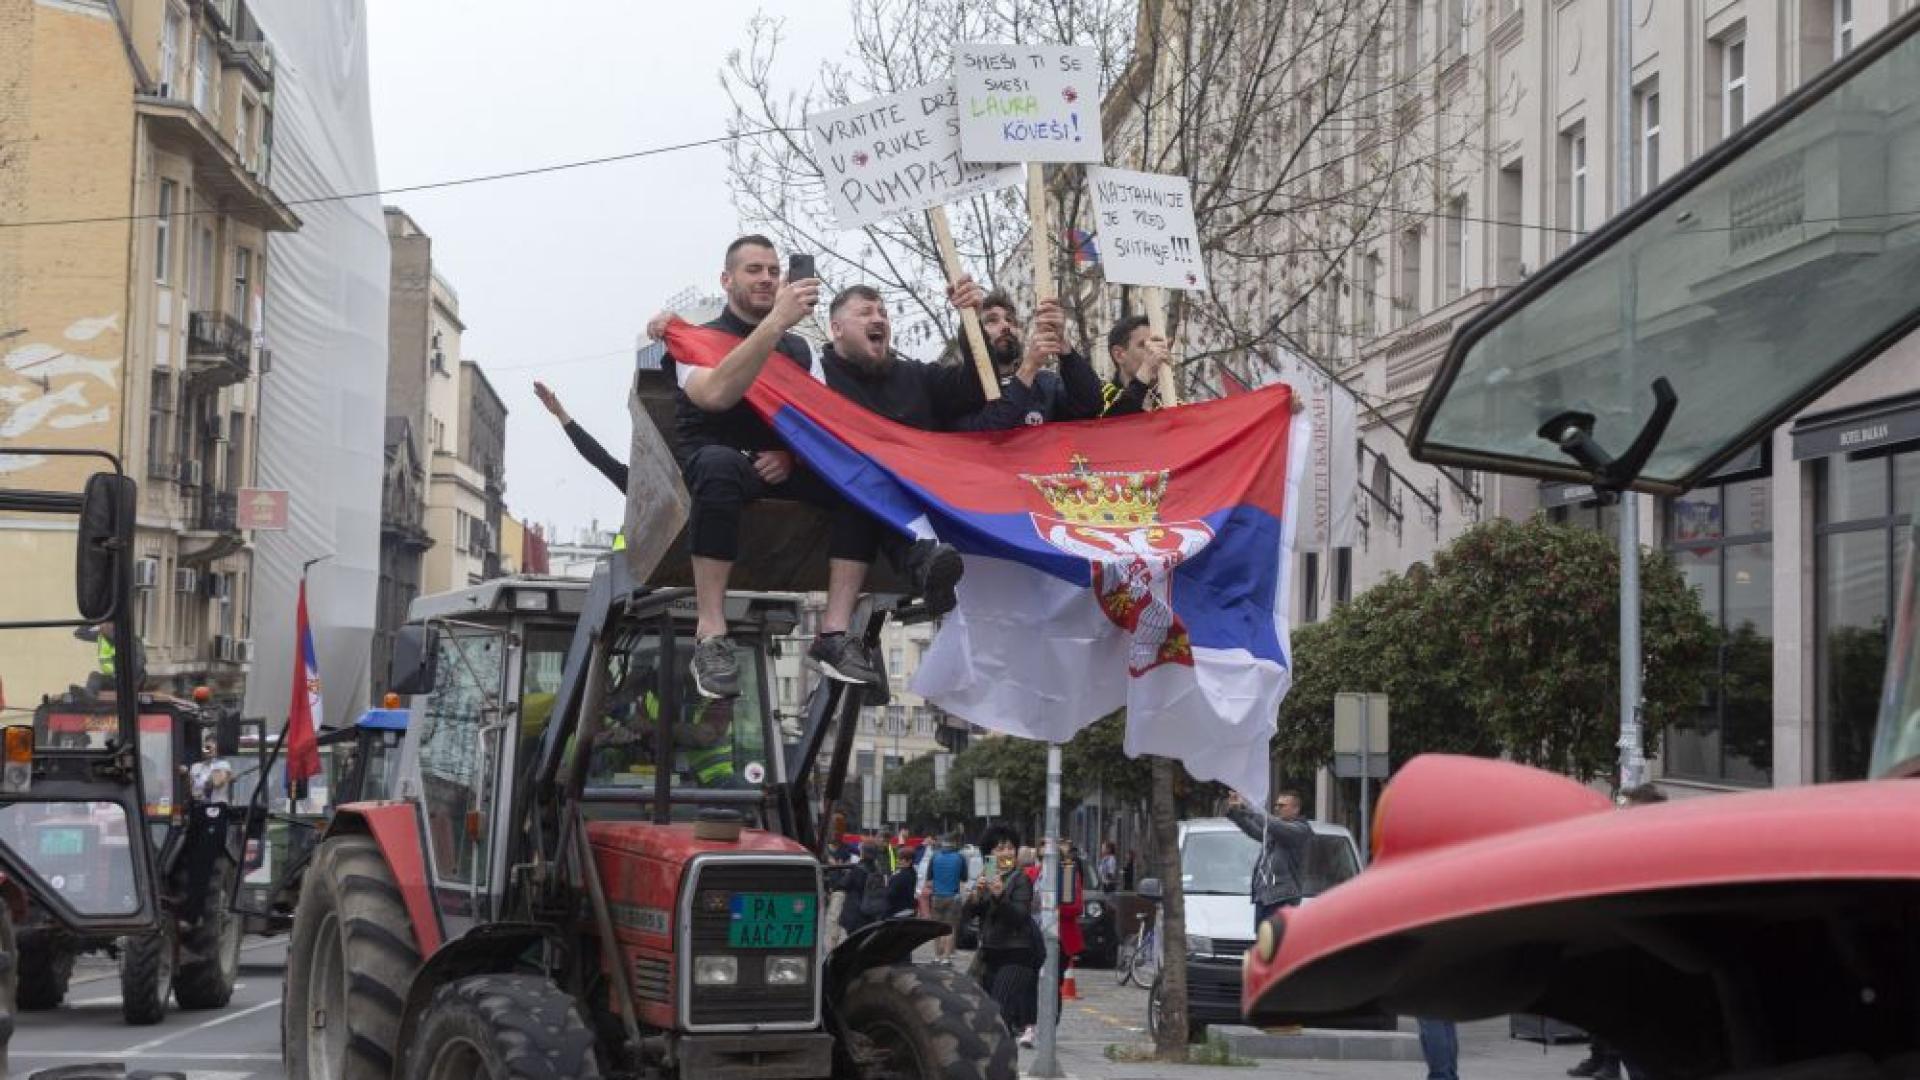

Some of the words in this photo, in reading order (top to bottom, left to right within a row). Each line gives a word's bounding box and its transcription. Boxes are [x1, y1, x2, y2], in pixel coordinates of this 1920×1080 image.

[1028, 54, 1046, 69] TI
[1059, 55, 1082, 72] SE
[815, 103, 907, 146] VRATITE
[920, 85, 959, 116] DRŽ
[970, 94, 1041, 118] LAURA
[830, 152, 846, 175] U
[872, 127, 933, 161] RUKE
[1101, 211, 1120, 227] JE
[753, 896, 777, 920] PA
